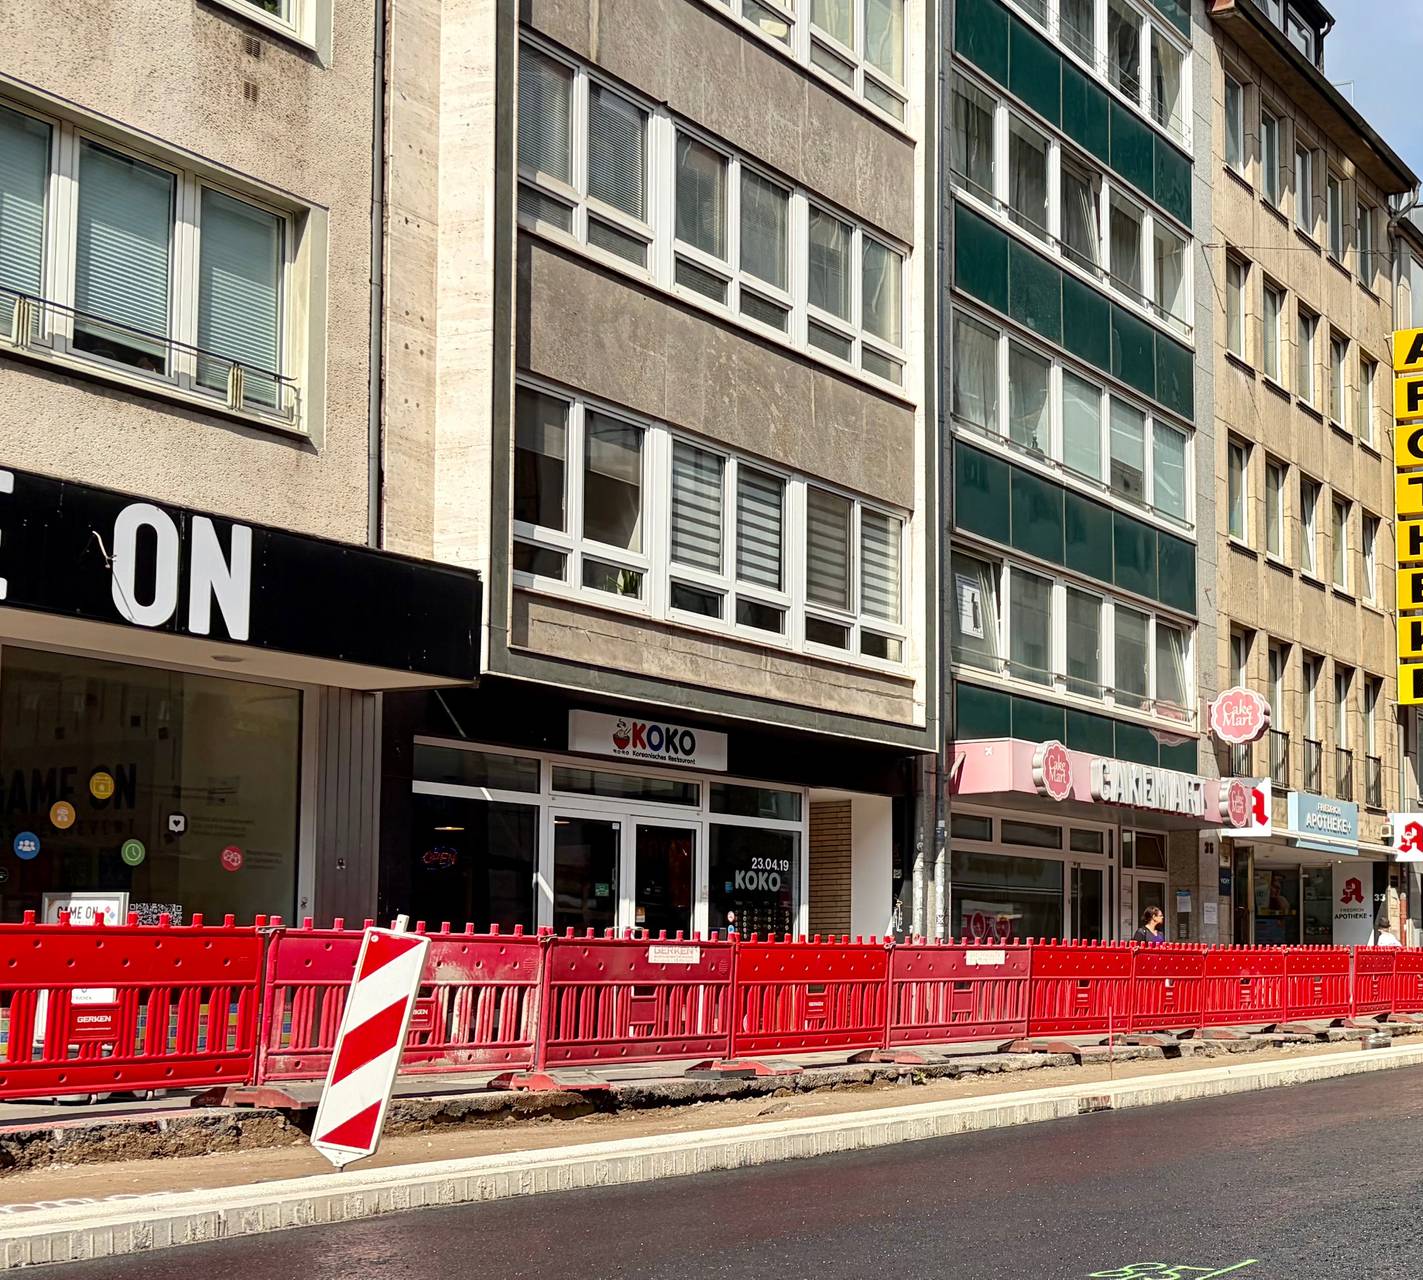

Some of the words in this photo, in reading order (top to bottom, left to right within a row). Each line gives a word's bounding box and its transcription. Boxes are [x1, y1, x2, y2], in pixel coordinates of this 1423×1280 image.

[112, 503, 252, 641] ON
[1222, 700, 1253, 717] Cake
[1222, 712, 1253, 727] Mart
[632, 722, 696, 756] KOKO
[1048, 753, 1066, 772] Cake
[1048, 769, 1067, 785] Mart
[1097, 758, 1206, 816] CAKEMART
[751, 857, 789, 871] 23.04.19
[735, 870, 781, 892] KOKO
[77, 1015, 112, 1023] GERKEN
